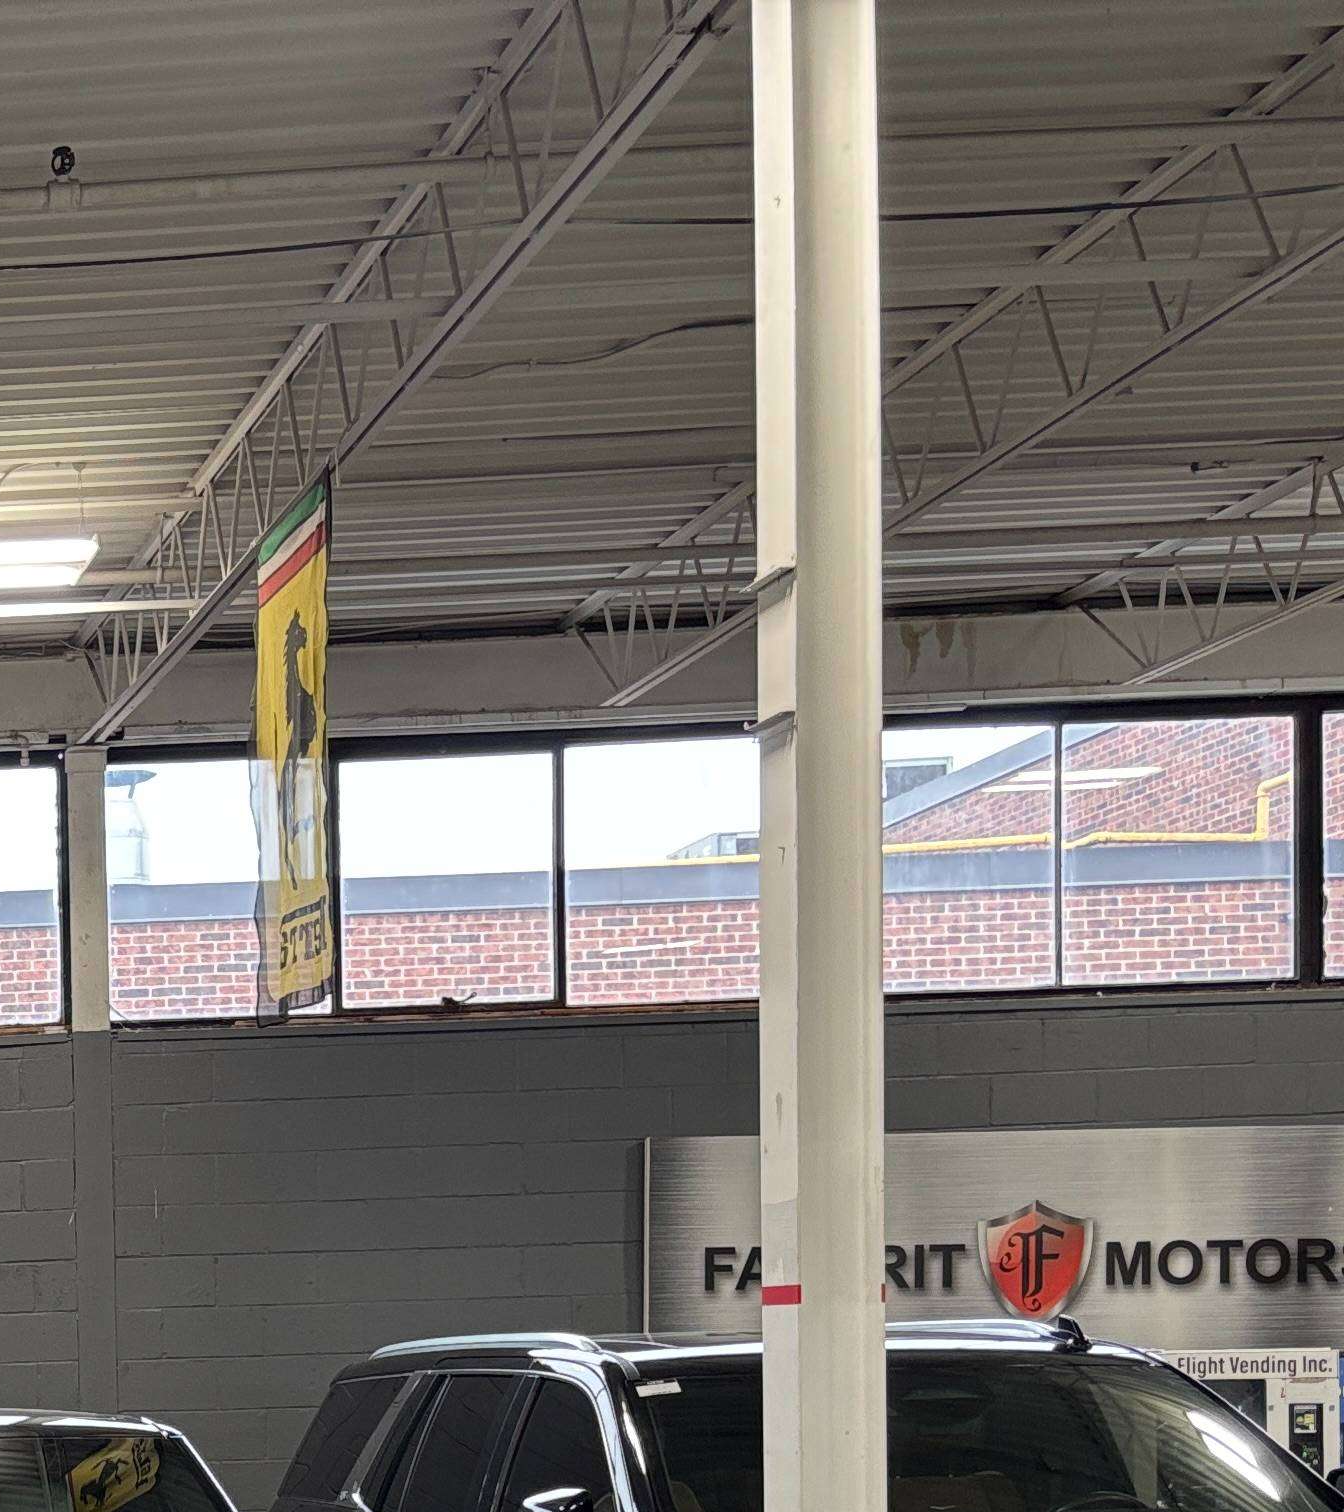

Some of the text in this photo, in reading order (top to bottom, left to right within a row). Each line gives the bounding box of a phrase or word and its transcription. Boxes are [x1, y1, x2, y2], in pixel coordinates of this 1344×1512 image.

[704, 1244, 966, 1291] FARIT
[1105, 1238, 1344, 1287] MOTOR
[1178, 1355, 1332, 1379] Flight Vending Inc.
